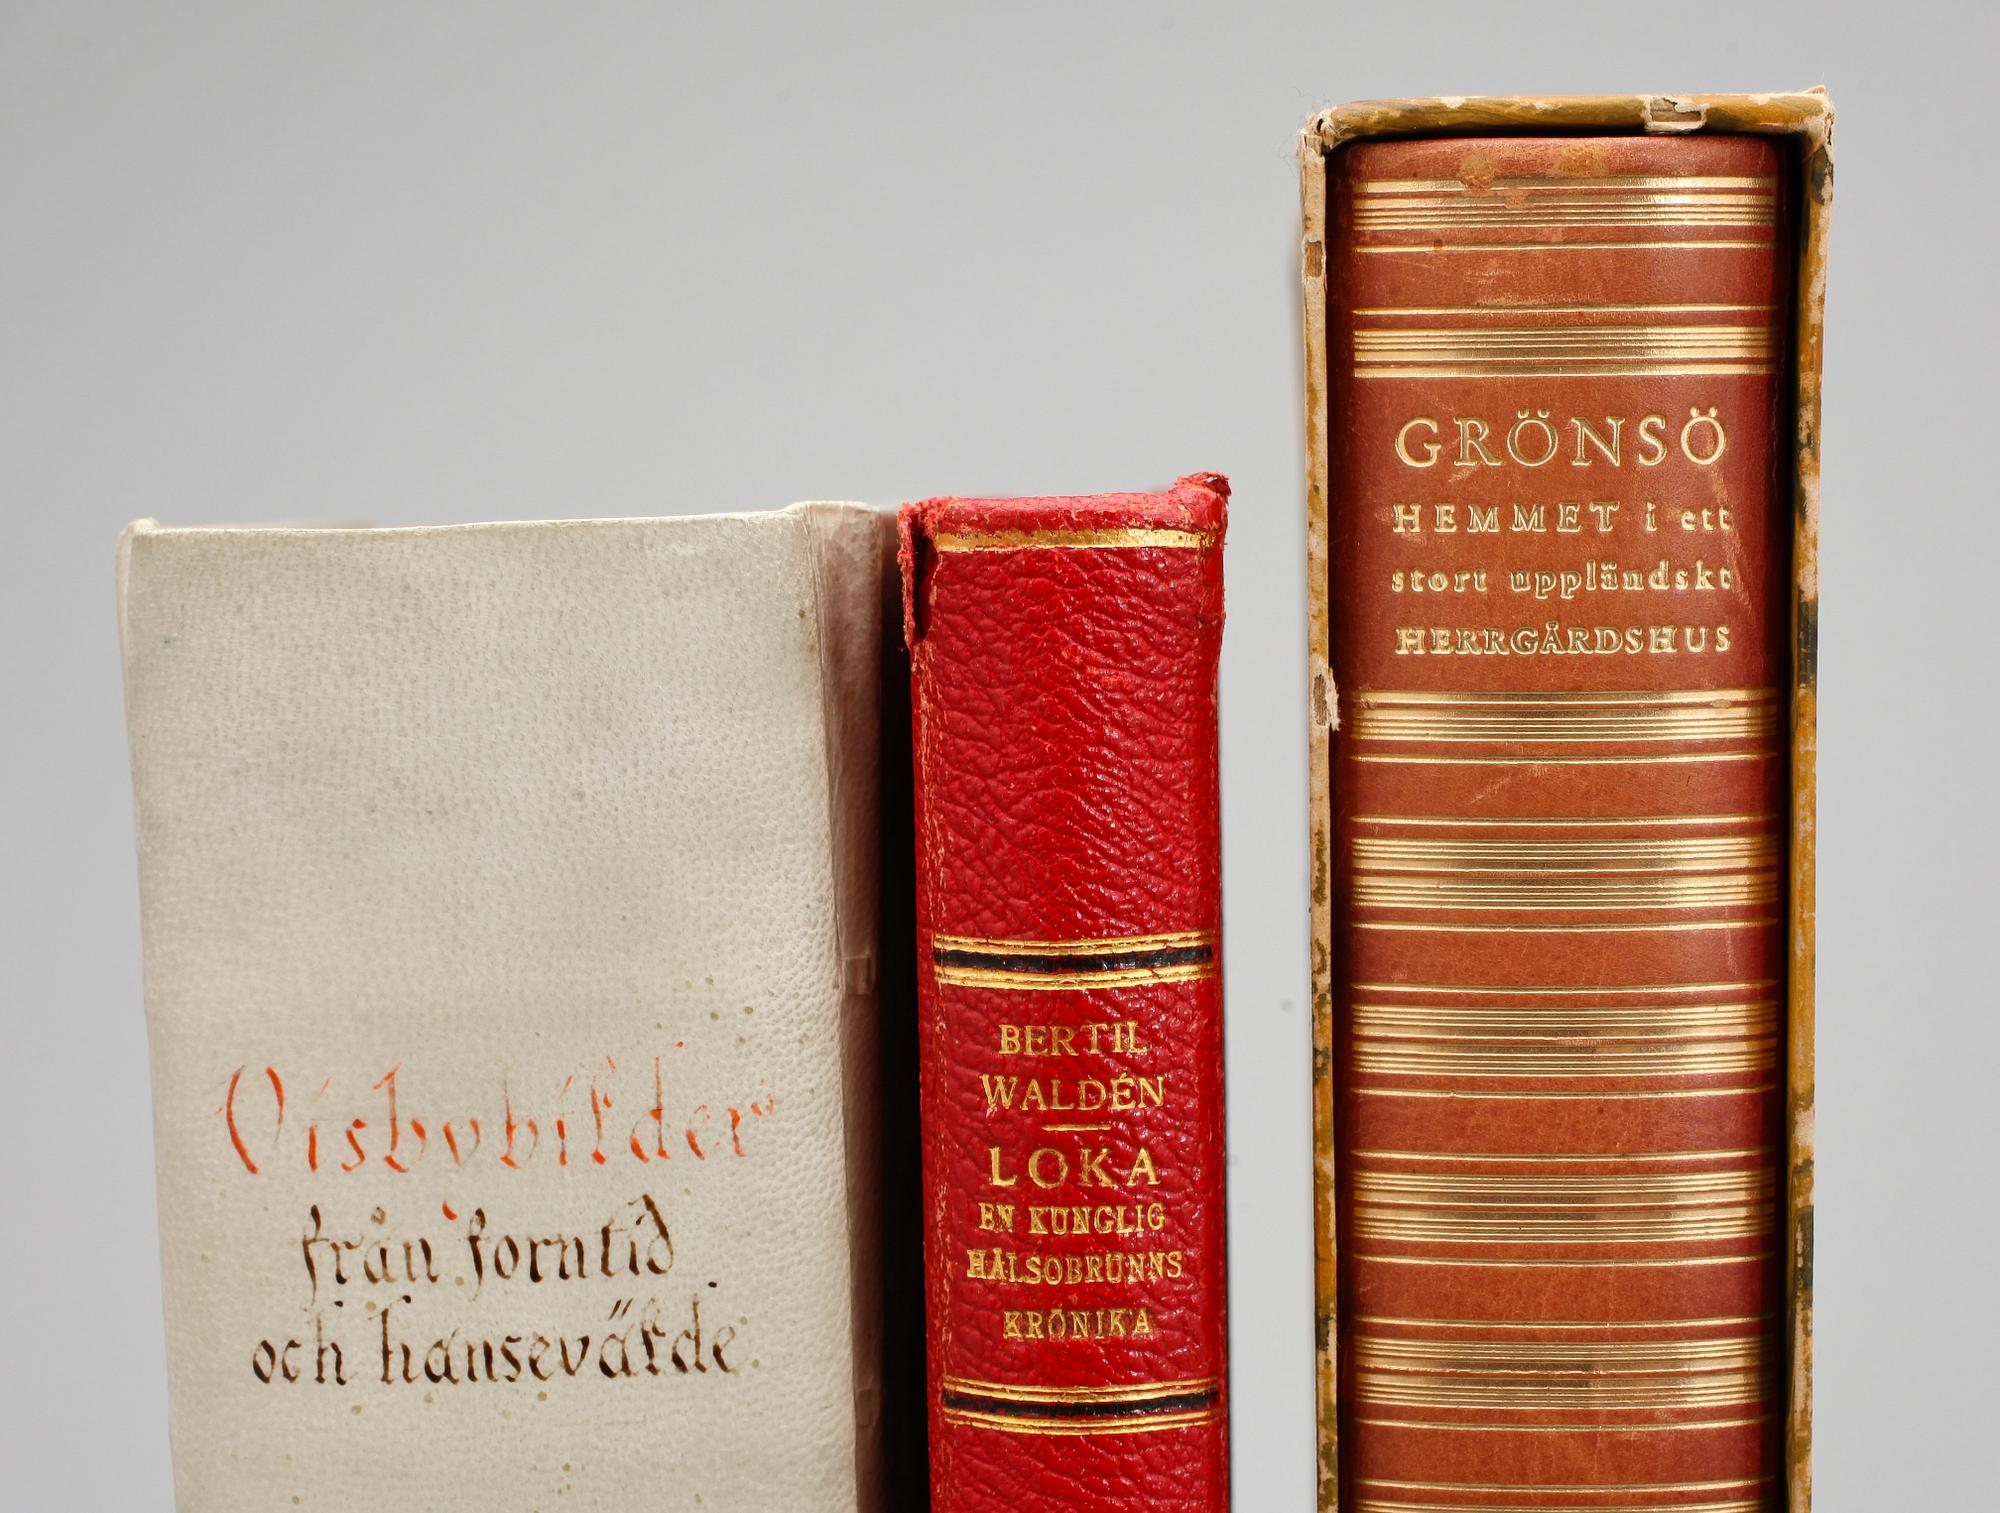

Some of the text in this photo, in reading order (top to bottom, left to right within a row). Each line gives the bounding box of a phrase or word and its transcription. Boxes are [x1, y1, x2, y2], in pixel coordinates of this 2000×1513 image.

[1394, 405, 1727, 468] GRÖNSÖ
[1393, 501, 1732, 533] HEMMET i ett
[1391, 559, 1733, 600] stort uppländskt
[1395, 620, 1732, 655] HERRGÅRDSHUS
[998, 1021, 1149, 1057] BERTIL
[980, 1074, 1165, 1111] WALDÉN
[988, 1146, 1161, 1189] LOKA
[979, 1202, 1166, 1236] EN KUNGLIG
[303, 1193, 675, 1311] från forntid
[1003, 1307, 1154, 1340] KRÖNIKA
[252, 1301, 356, 1386] och
